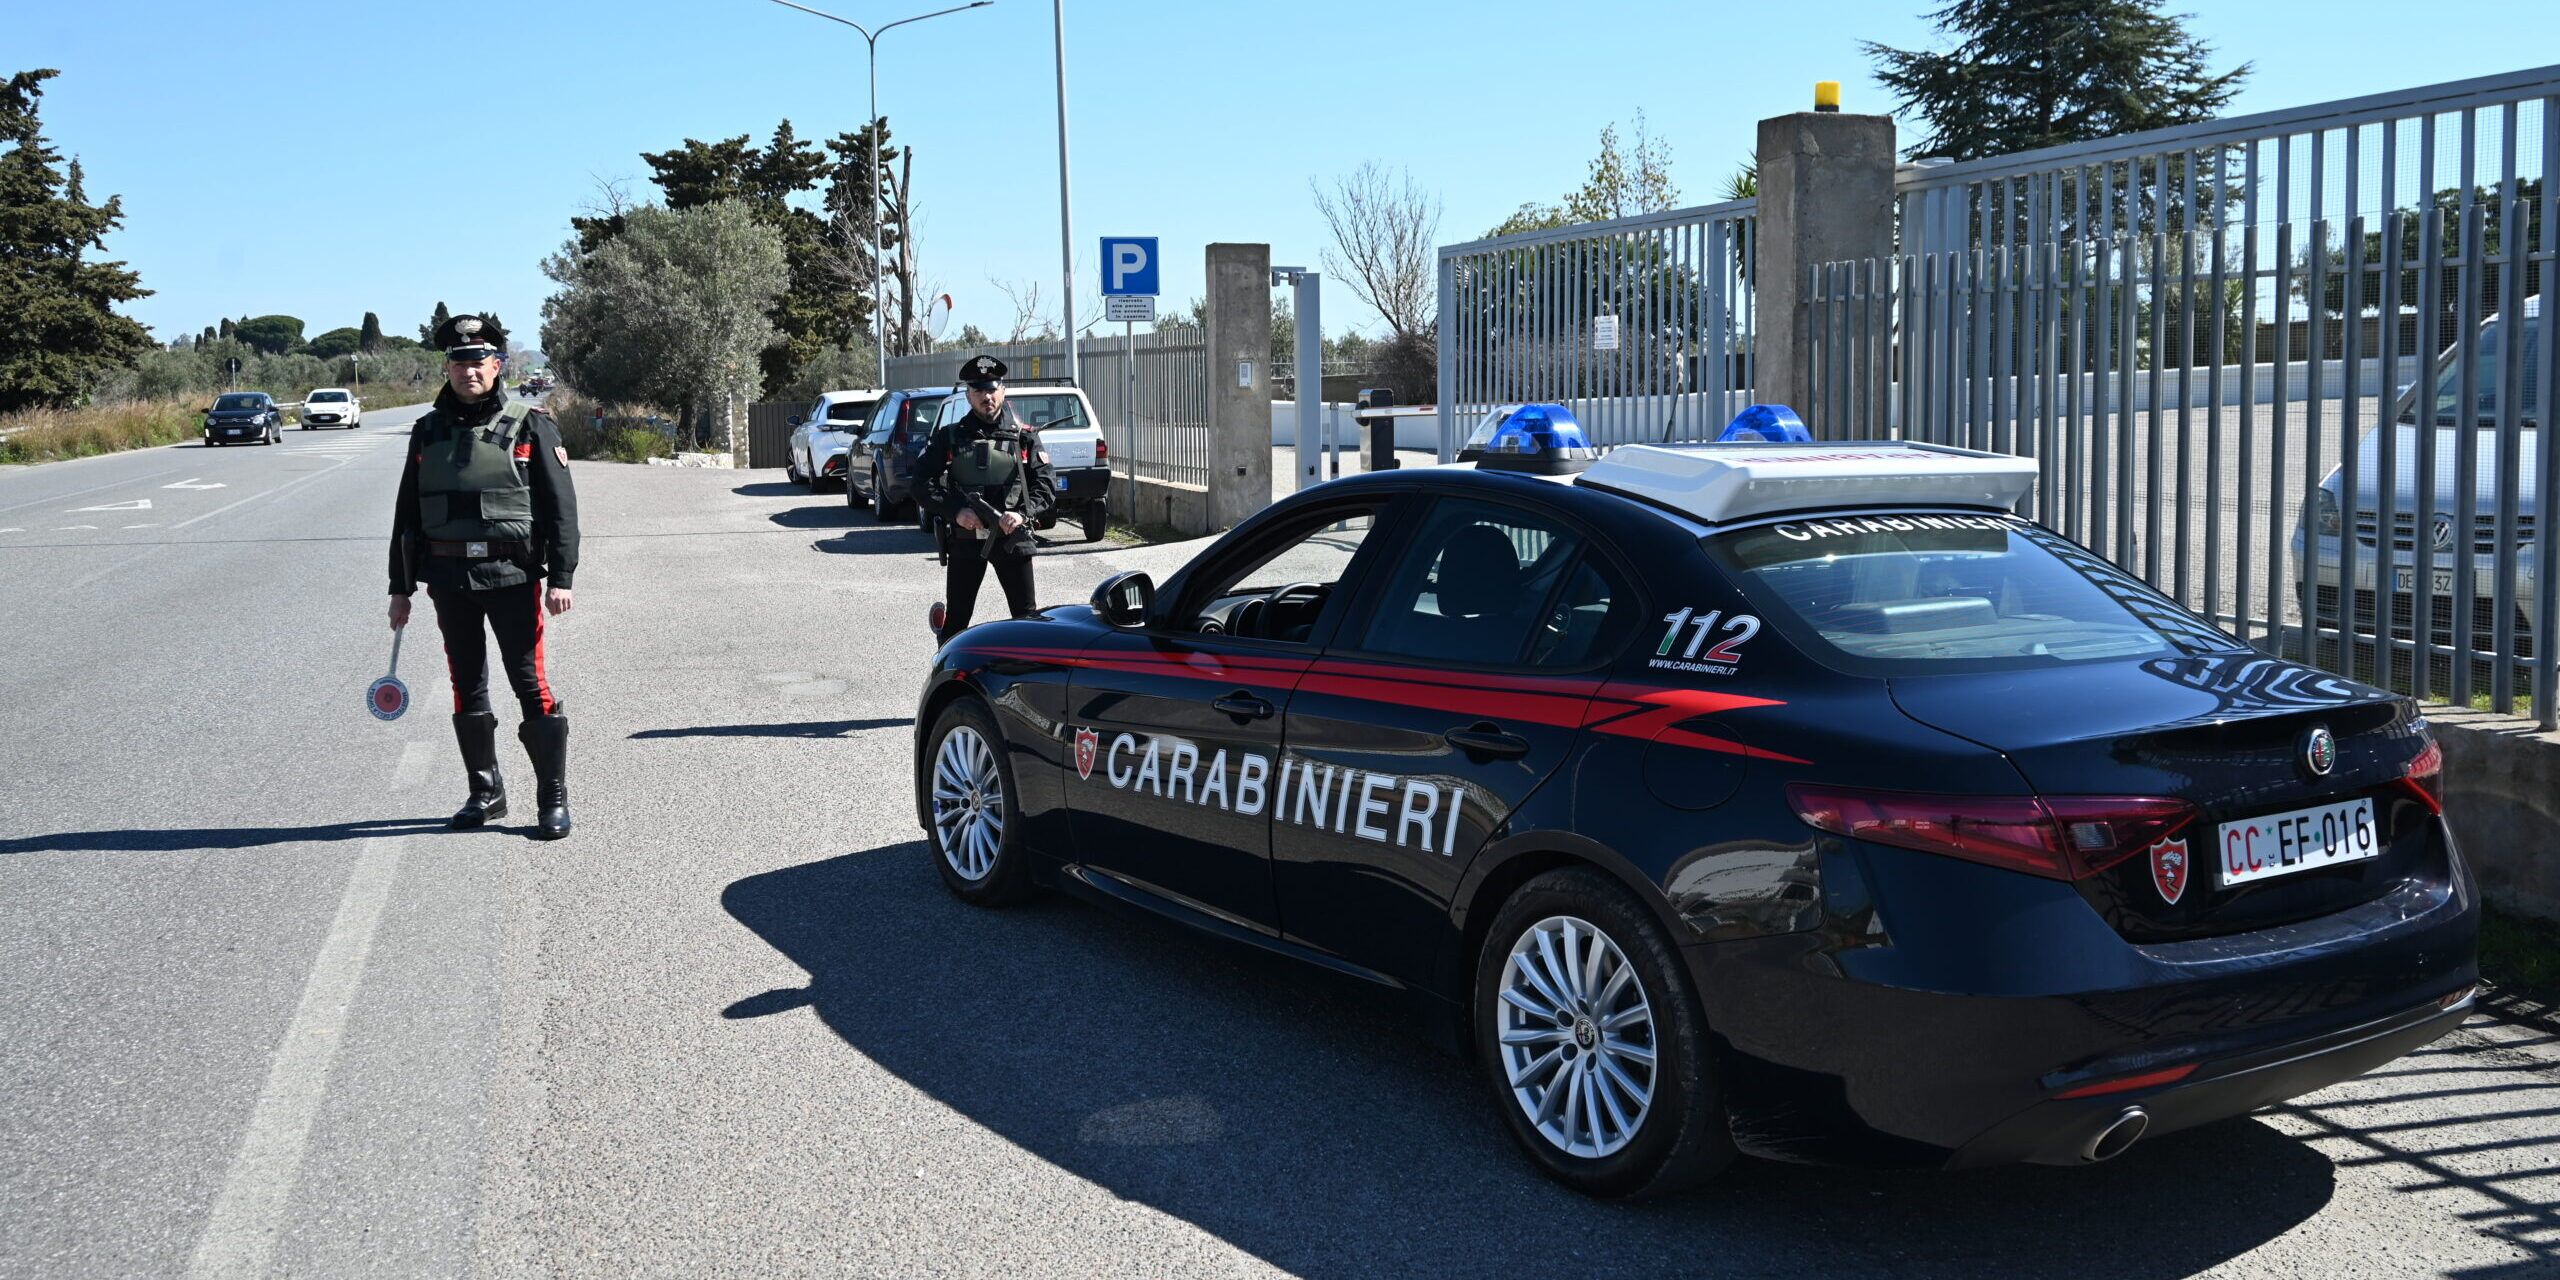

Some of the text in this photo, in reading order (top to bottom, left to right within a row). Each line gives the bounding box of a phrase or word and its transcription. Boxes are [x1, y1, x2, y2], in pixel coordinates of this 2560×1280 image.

[1113, 243, 1147, 290] P
[1774, 514, 2024, 541] CARABINIERI
[1656, 606, 1761, 664] 112
[1648, 659, 1738, 676] WWW.CARABINIERI.IT
[1107, 733, 1464, 857] CARABINIERI
[2227, 806, 2371, 876] CC EF 016
